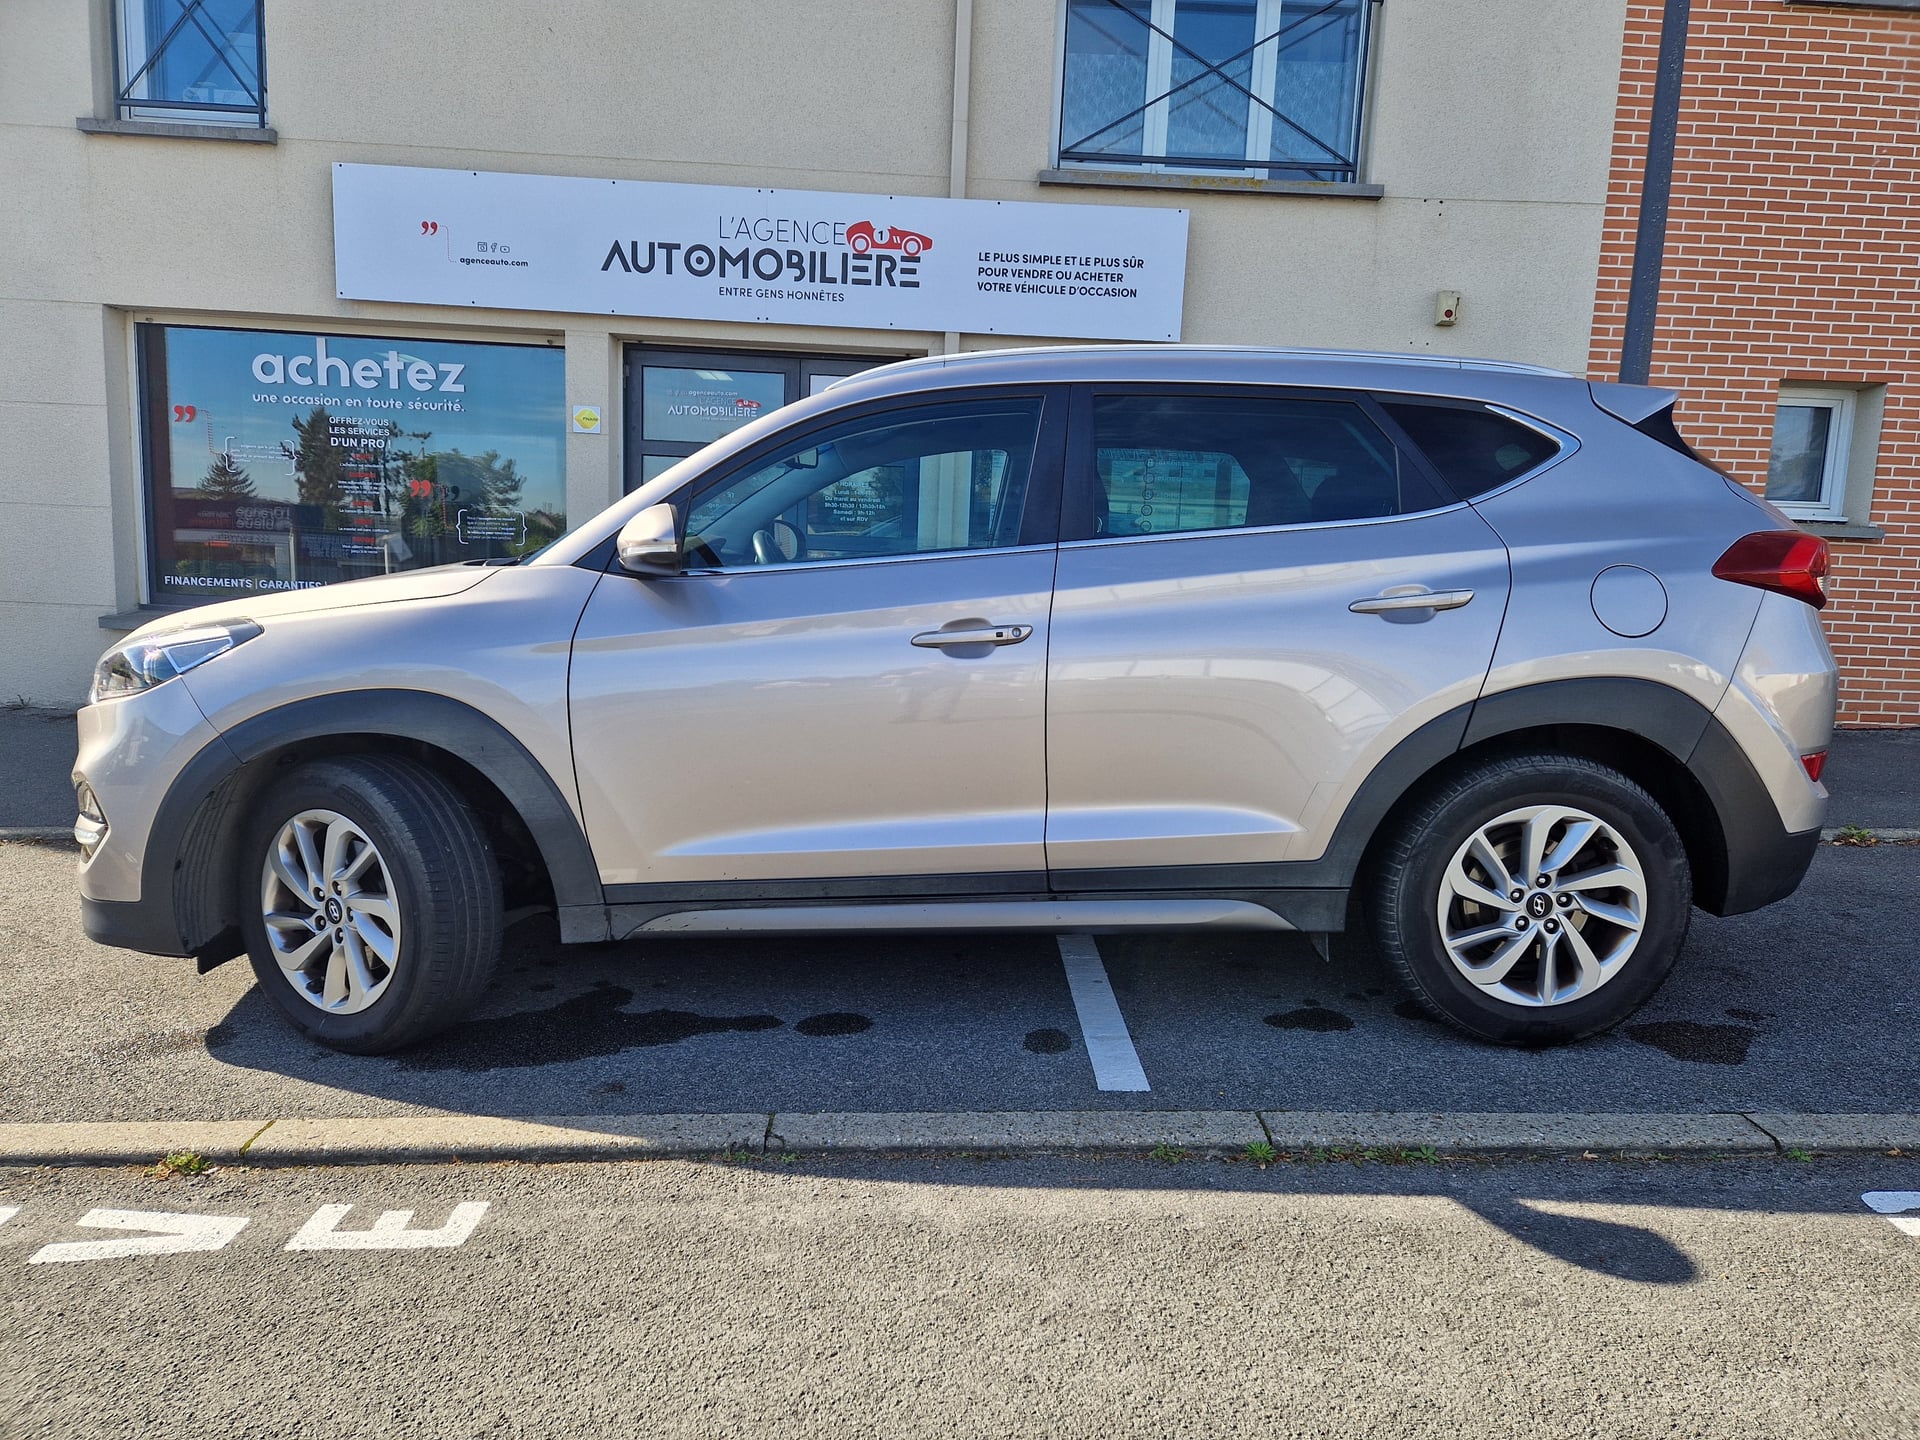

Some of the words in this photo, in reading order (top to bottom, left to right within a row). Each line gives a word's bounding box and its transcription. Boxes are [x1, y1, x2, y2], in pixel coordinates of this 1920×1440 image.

[718, 215, 847, 246] L'AGENCE
[459, 257, 529, 268] agenceauto.com
[978, 252, 991, 262] LE
[993, 252, 1020, 263] PLUS
[1022, 254, 1062, 265] SIMPLE
[1064, 256, 1077, 266] ET
[1079, 256, 1091, 266] LE
[1093, 257, 1120, 268] PLUS
[1122, 256, 1145, 269] SÛR
[978, 267, 1008, 278] POUR
[1011, 268, 1053, 280] VENDRE
[1055, 270, 1072, 281] OU
[1074, 271, 1124, 283] ACHETER
[719, 286, 753, 298] ENTRE
[756, 288, 785, 299] GENS
[787, 289, 845, 302] HONNÊTES
[977, 281, 1012, 293] VOTRE
[1014, 281, 1067, 295] VÉHICULE
[1068, 286, 1138, 298] D'OCCASION
[252, 337, 466, 393] achetez
[252, 393, 279, 404] une
[282, 393, 341, 407] occasion
[345, 398, 362, 408] en
[367, 397, 403, 410] toute
[407, 397, 466, 412] sécurité.
[329, 416, 389, 427] OFFREZ-VOUS
[329, 427, 346, 435] LES
[347, 427, 390, 437] SERVICES
[330, 437, 358, 448] D'UN
[360, 438, 385, 449] PRO
[164, 575, 253, 588] FINANCEMENTS
